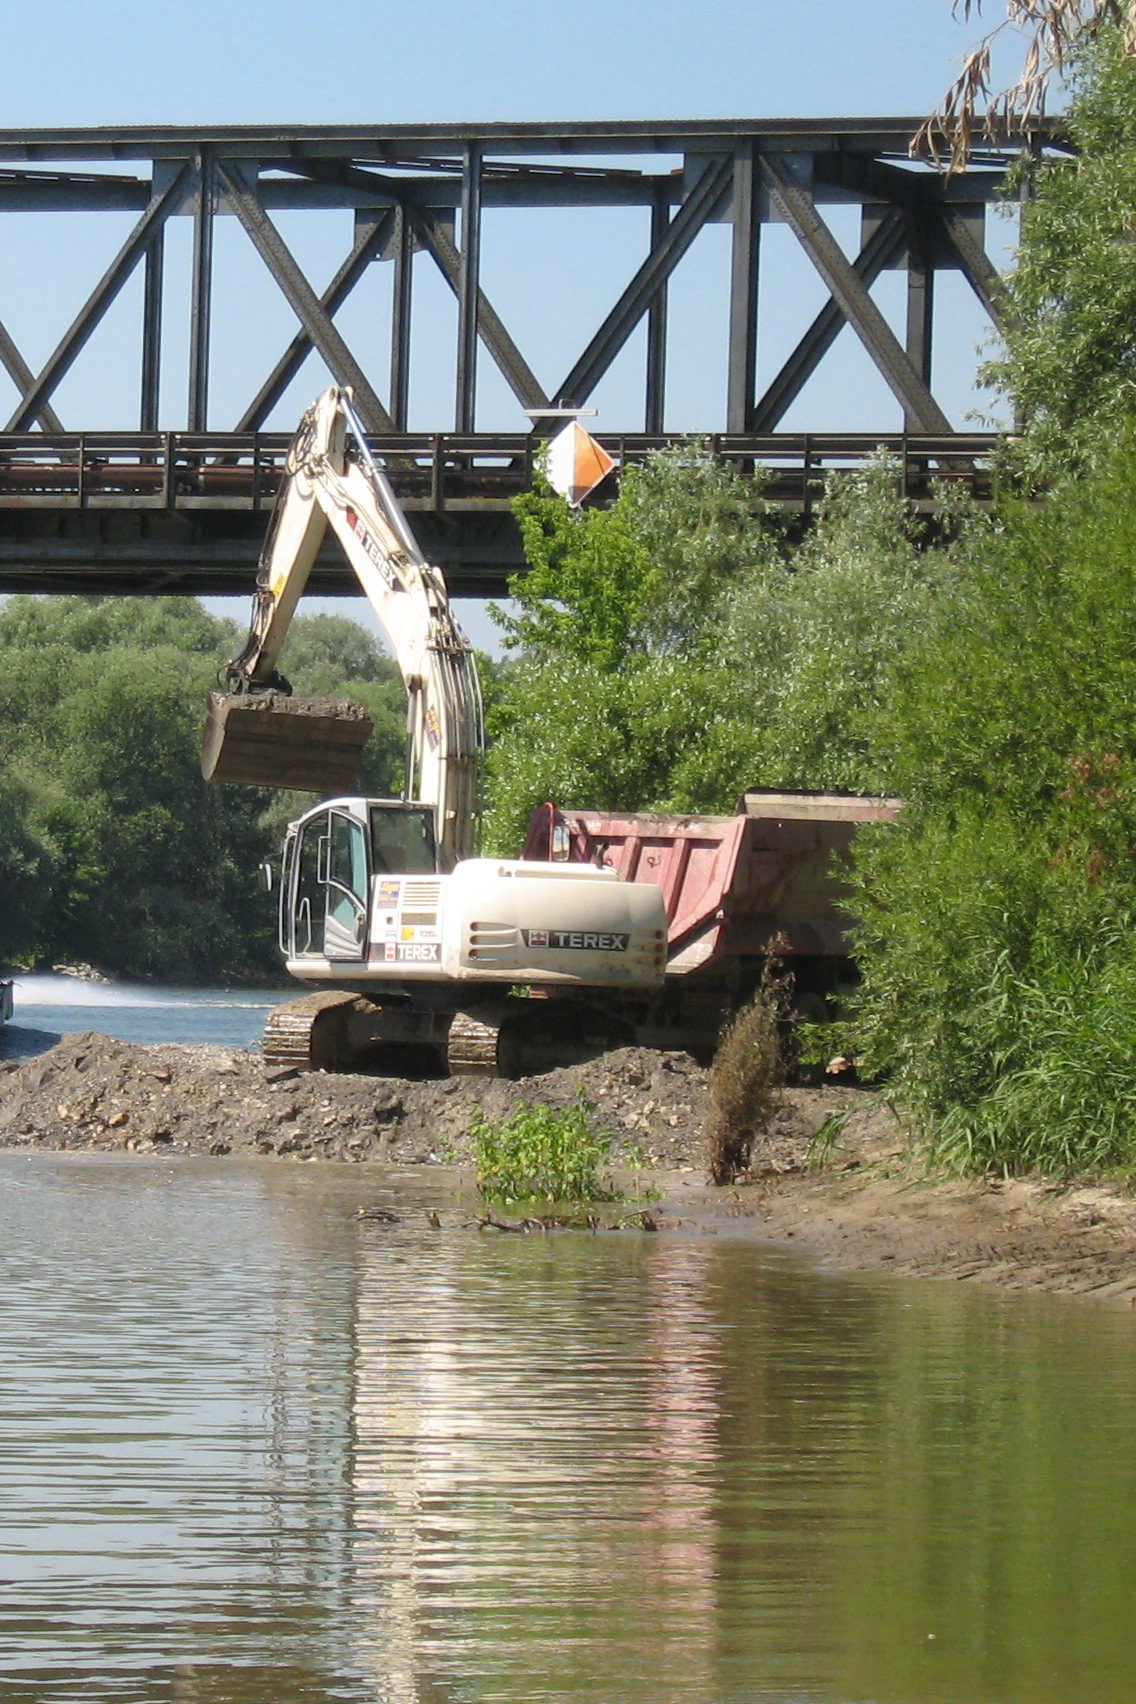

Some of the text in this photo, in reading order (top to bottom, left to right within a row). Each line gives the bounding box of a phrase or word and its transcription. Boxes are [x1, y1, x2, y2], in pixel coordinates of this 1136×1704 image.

[364, 534, 395, 588] TEREX
[554, 932, 625, 950] TEREX
[397, 945, 438, 960] TEREX
